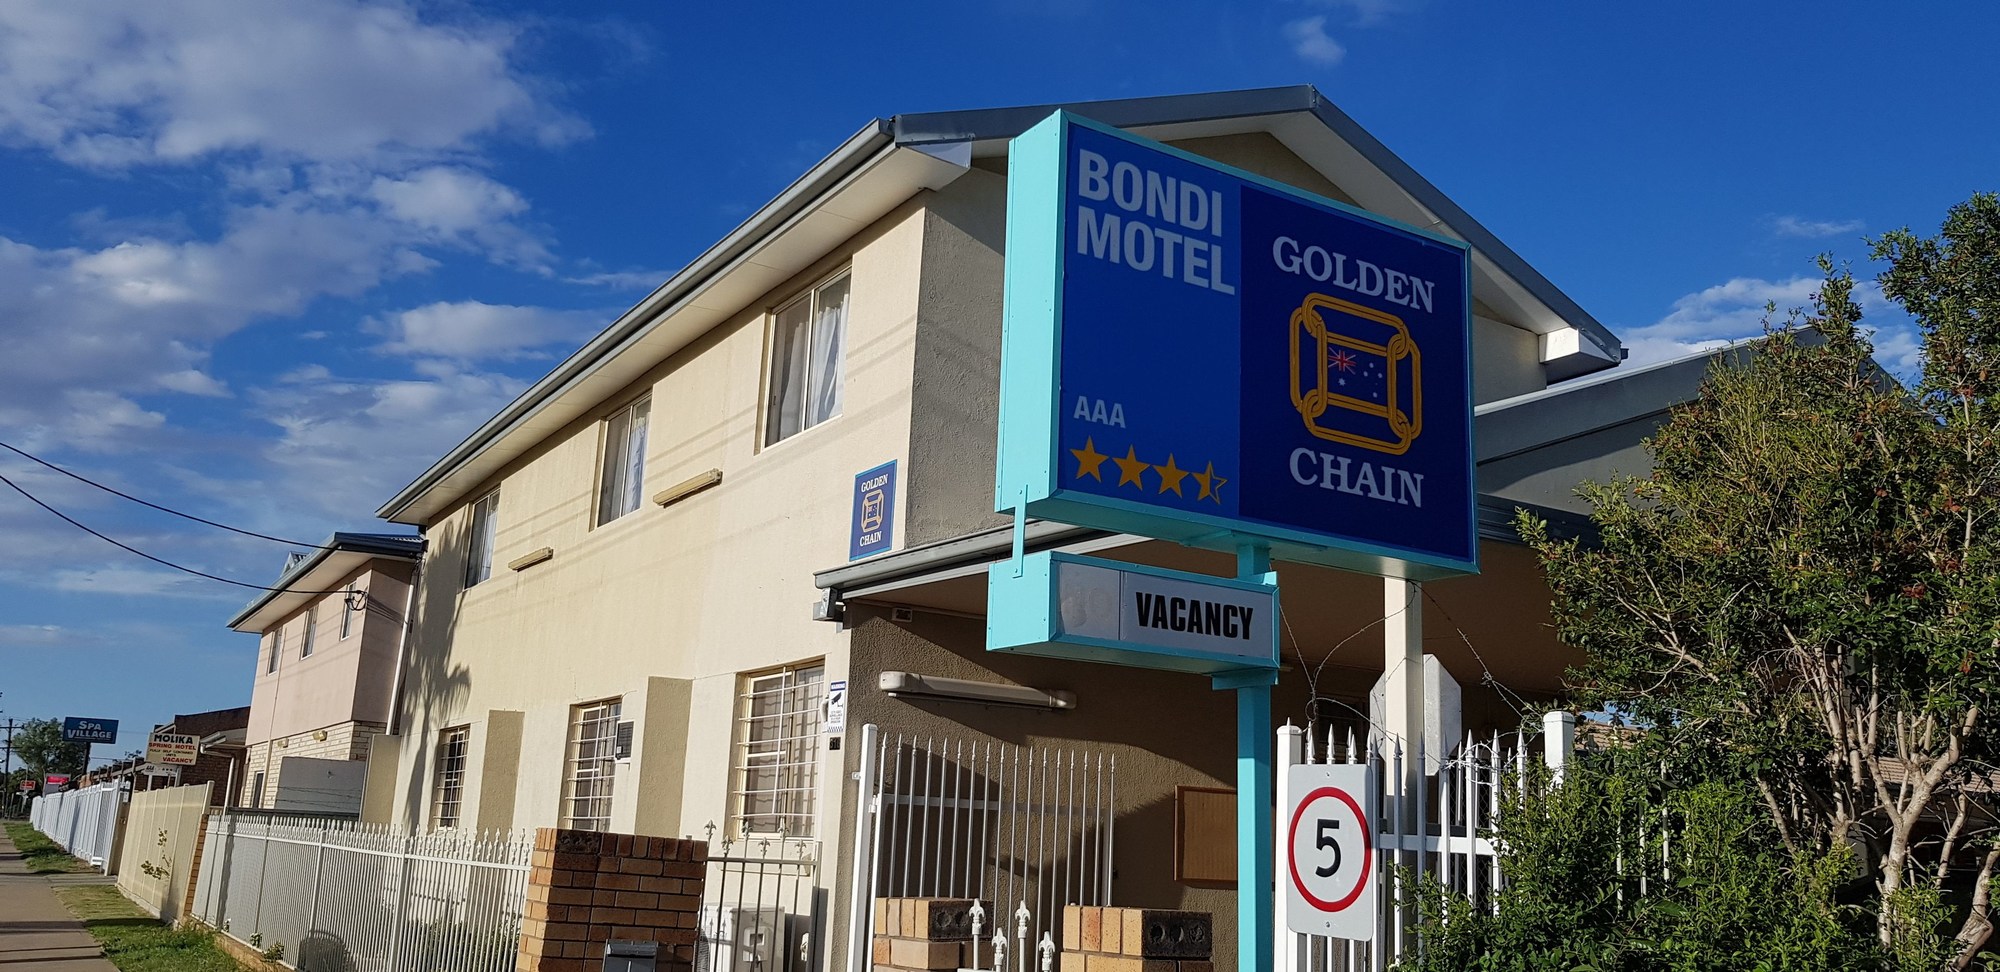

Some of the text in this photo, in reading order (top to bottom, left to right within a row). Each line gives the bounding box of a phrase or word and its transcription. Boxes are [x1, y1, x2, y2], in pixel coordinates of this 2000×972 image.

[1078, 148, 1222, 238] BONDI
[1077, 204, 1236, 296] MOTEL
[1272, 235, 1435, 314] GOLDEN
[1073, 395, 1127, 429] AAA
[861, 473, 888, 493] GOLDEN
[1289, 447, 1424, 508] CHAIN
[859, 530, 882, 547] CHAIN
[1135, 591, 1253, 640] VACANCY
[67, 729, 112, 739] VILLAGE
[78, 720, 102, 731] SPA
[153, 734, 194, 744] MOLIKA
[162, 756, 194, 764] VACANCY
[1315, 818, 1342, 878] 5
